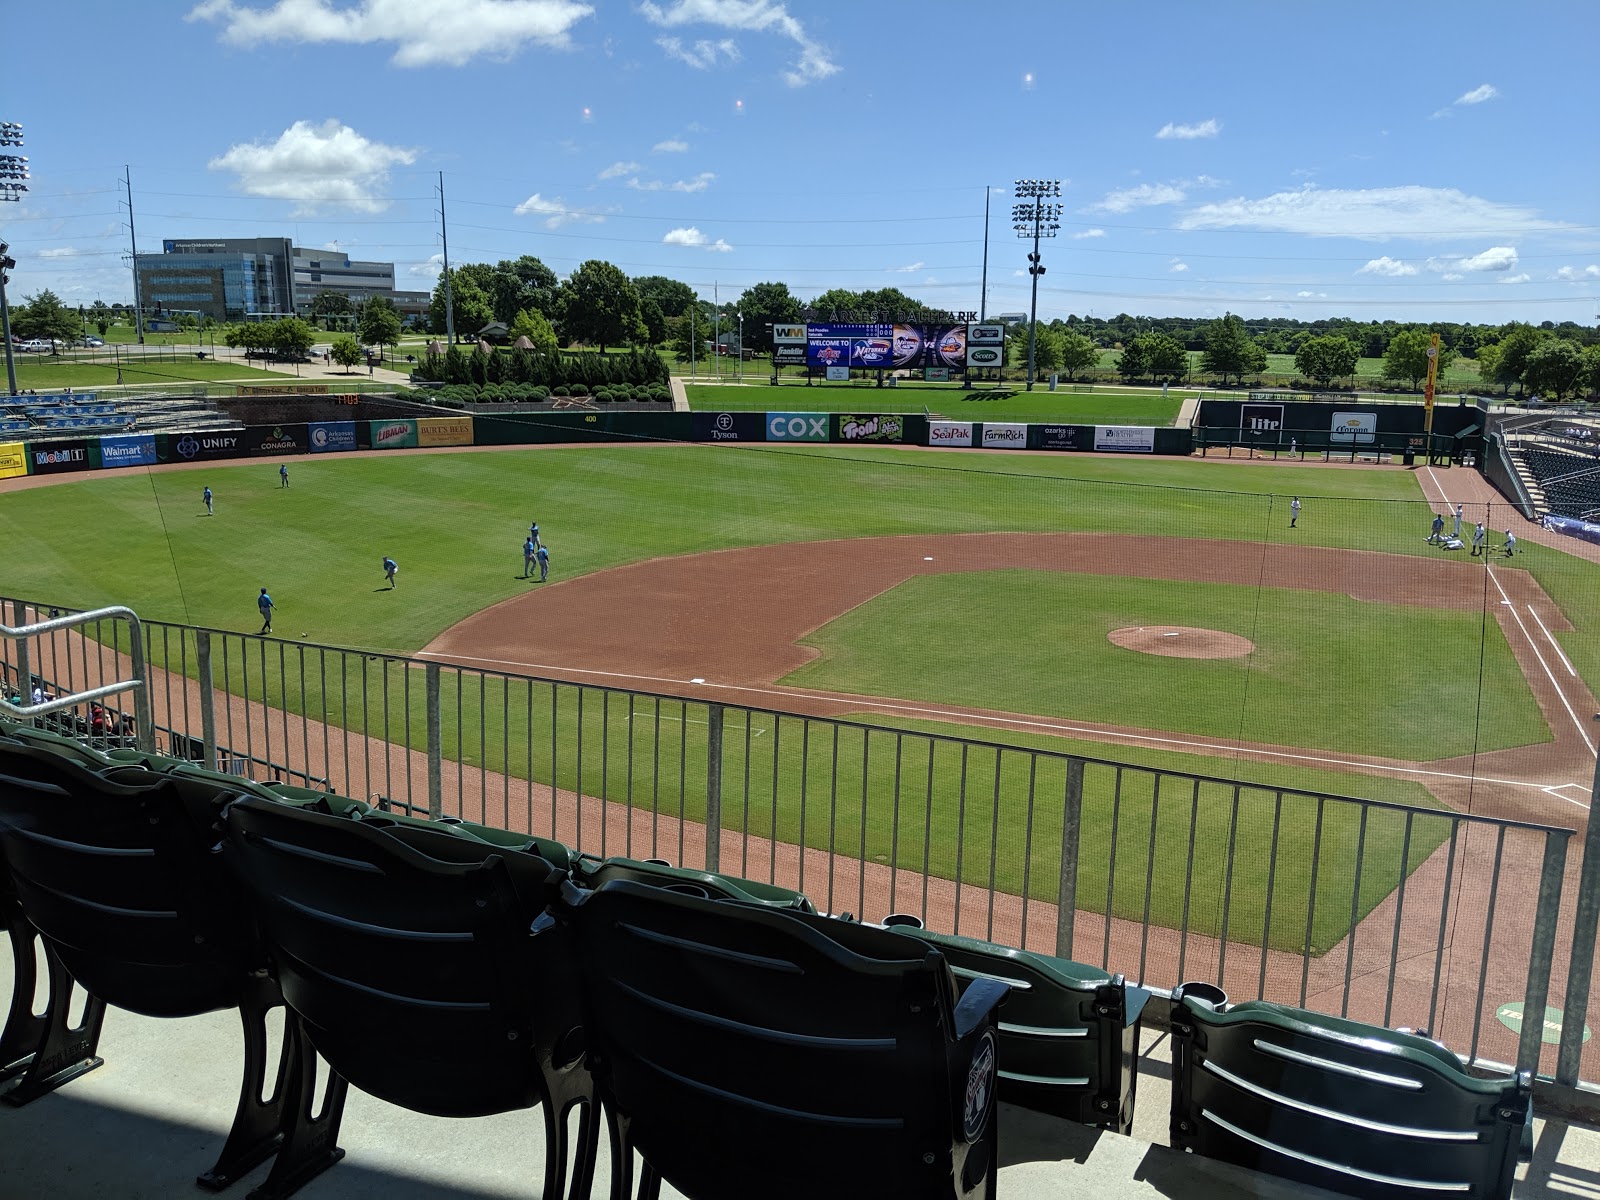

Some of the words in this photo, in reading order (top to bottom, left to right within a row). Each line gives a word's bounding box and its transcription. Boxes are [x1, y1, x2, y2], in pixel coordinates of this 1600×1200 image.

[770, 417, 826, 437] COX
[843, 417, 878, 439] Trolli
[378, 426, 408, 442] LIBMAN
[710, 430, 738, 440] Tyson
[932, 428, 969, 440] SeaPak
[203, 438, 237, 448] UNIFY
[36, 450, 70, 464] Mobil
[103, 446, 141, 456] Walmart
